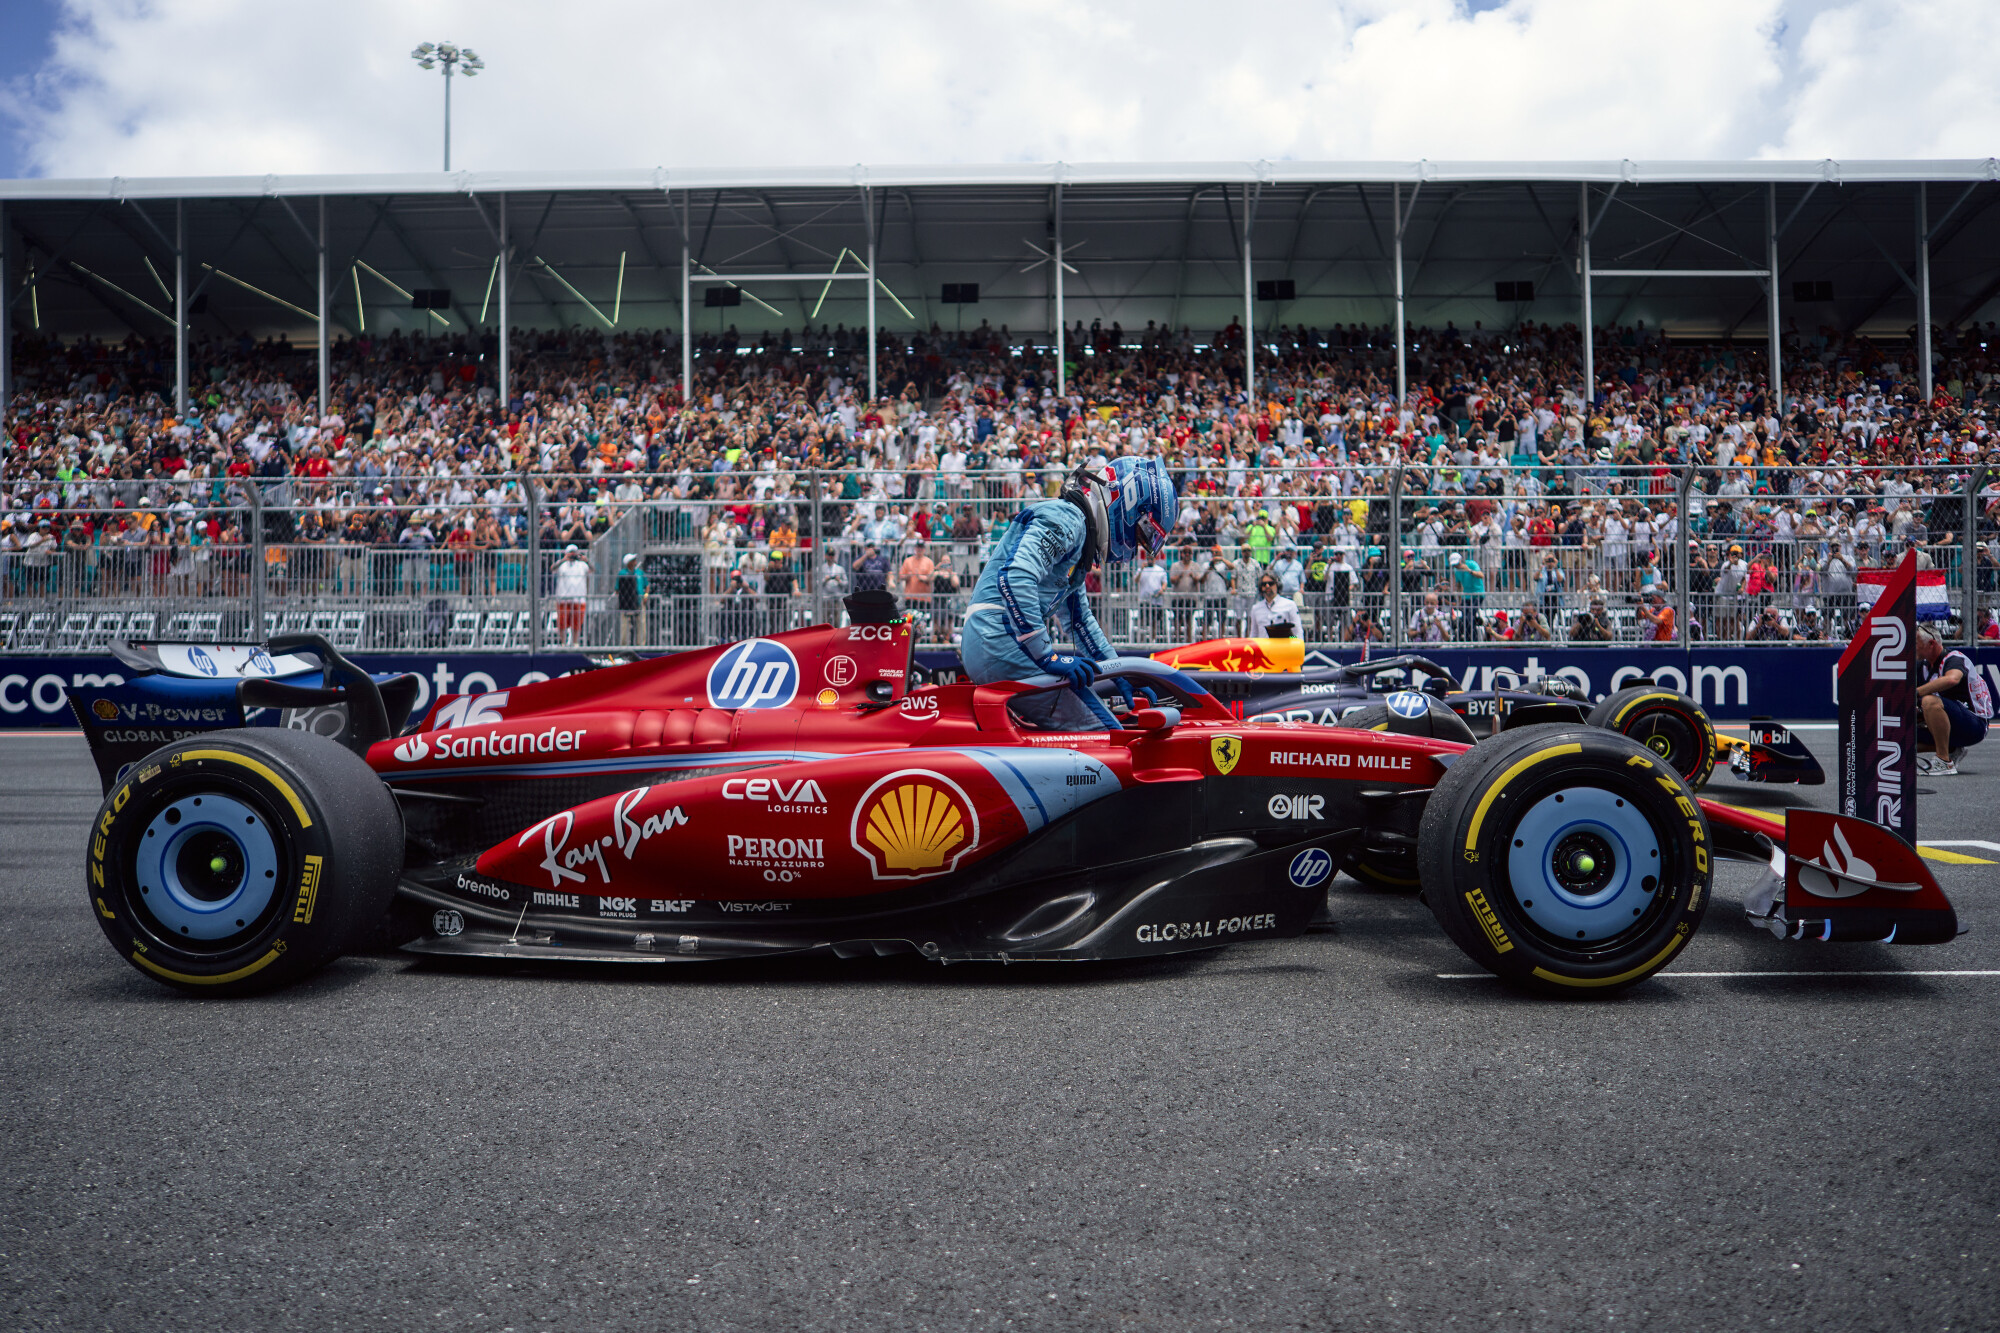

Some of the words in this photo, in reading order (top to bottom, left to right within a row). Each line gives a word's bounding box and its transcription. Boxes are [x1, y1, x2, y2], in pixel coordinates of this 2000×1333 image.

[848, 625, 892, 641] ZCG
[189, 646, 216, 677] hp
[715, 640, 792, 709] hp
[120, 703, 226, 721] V-Power
[432, 690, 510, 731] 16
[900, 696, 938, 711] aws
[1393, 691, 1426, 718] hp
[103, 730, 170, 743] GLOBAL
[434, 727, 587, 760] Santander
[1032, 734, 1078, 743] HARMAN
[1694, 710, 1705, 720] P
[1703, 722, 1716, 772] ZERO
[1750, 730, 1791, 744] Mobil
[1270, 751, 1351, 767] RICHARD
[1357, 754, 1412, 770] MILLE
[1877, 697, 1902, 829] RINT
[1066, 774, 1096, 786] PUMA
[767, 804, 828, 815] LOGISTICS
[1626, 754, 1653, 768] P
[1656, 773, 1708, 874] ZERO
[92, 783, 131, 889] ZERO
[727, 834, 825, 859] PERONI
[729, 859, 770, 867] NASTRO
[773, 860, 825, 868] AZZURRO
[1291, 849, 1330, 887] hp
[457, 873, 510, 900] brembo
[763, 869, 801, 883] 0.0%
[293, 854, 323, 924] PIRELLI
[533, 891, 580, 908] MAHLE
[97, 897, 116, 919] P
[599, 896, 637, 912] NGK
[650, 899, 695, 913] SKF
[434, 912, 463, 933] FIA
[619, 911, 637, 919] PLUGS
[1465, 887, 1515, 954] PIRELLI
[1136, 920, 1213, 943] GLOBAL
[1216, 913, 1276, 935] POKER
